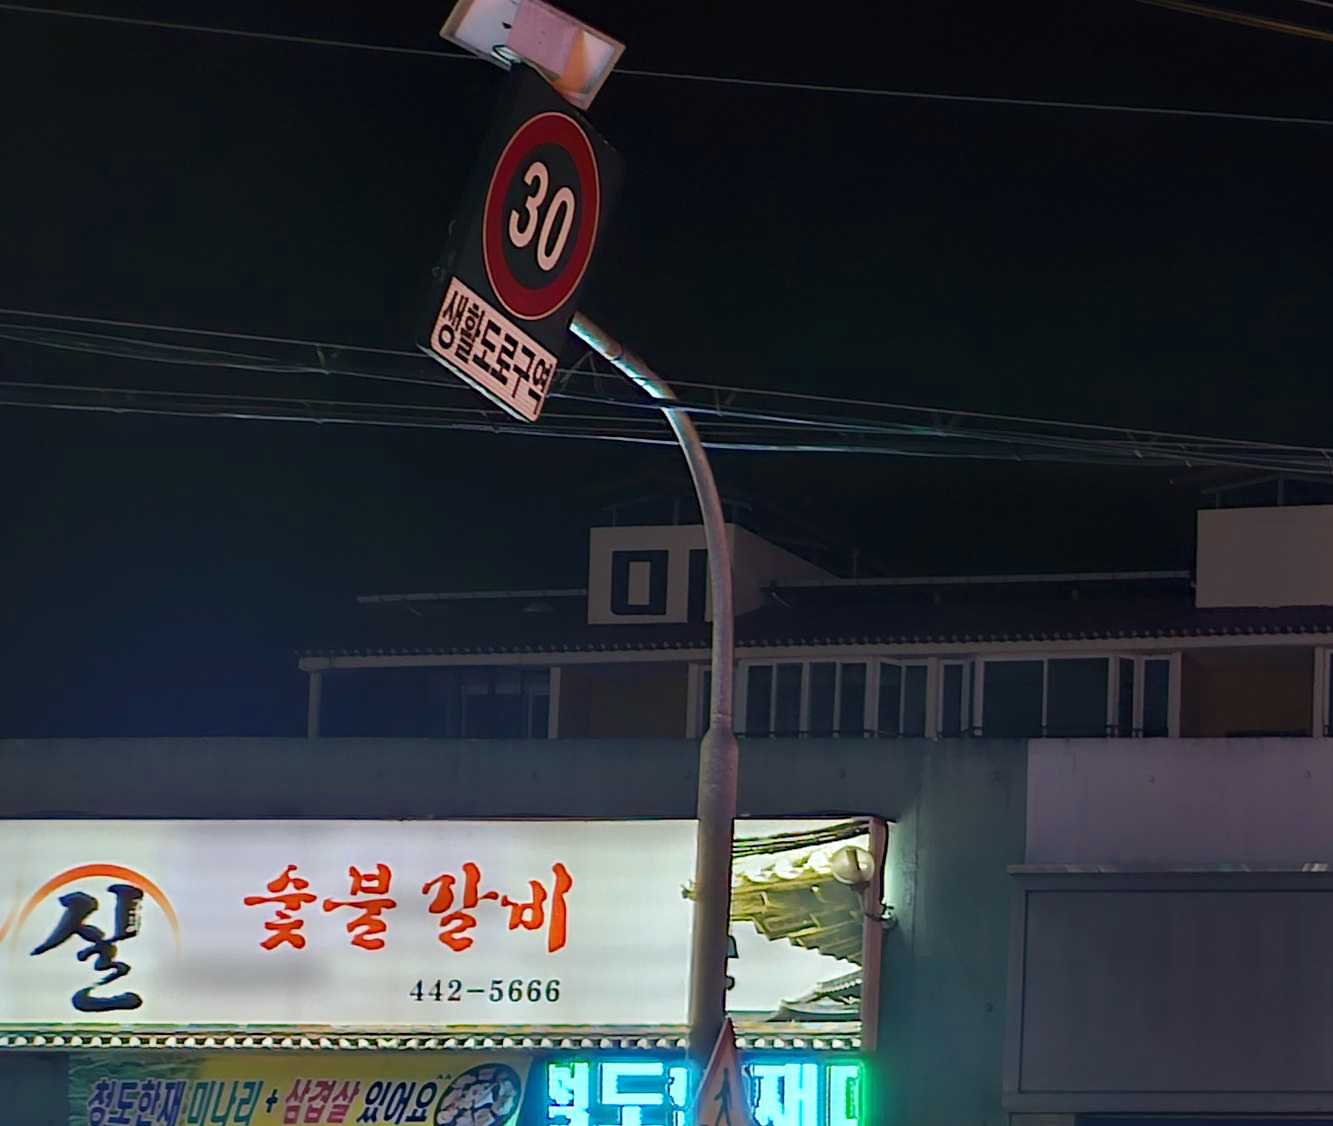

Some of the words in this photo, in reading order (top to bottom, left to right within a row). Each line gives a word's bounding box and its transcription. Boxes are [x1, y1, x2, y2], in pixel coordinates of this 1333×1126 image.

[508, 161, 576, 272] 30
[437, 290, 553, 416] 생활도로구역
[30, 882, 145, 1013] 실
[242, 862, 400, 952] 숯불
[421, 861, 574, 953] 갈비
[409, 978, 562, 1004] 442-5666
[188, 1080, 262, 1126] 미나리
[283, 1078, 358, 1124] 삼겹살
